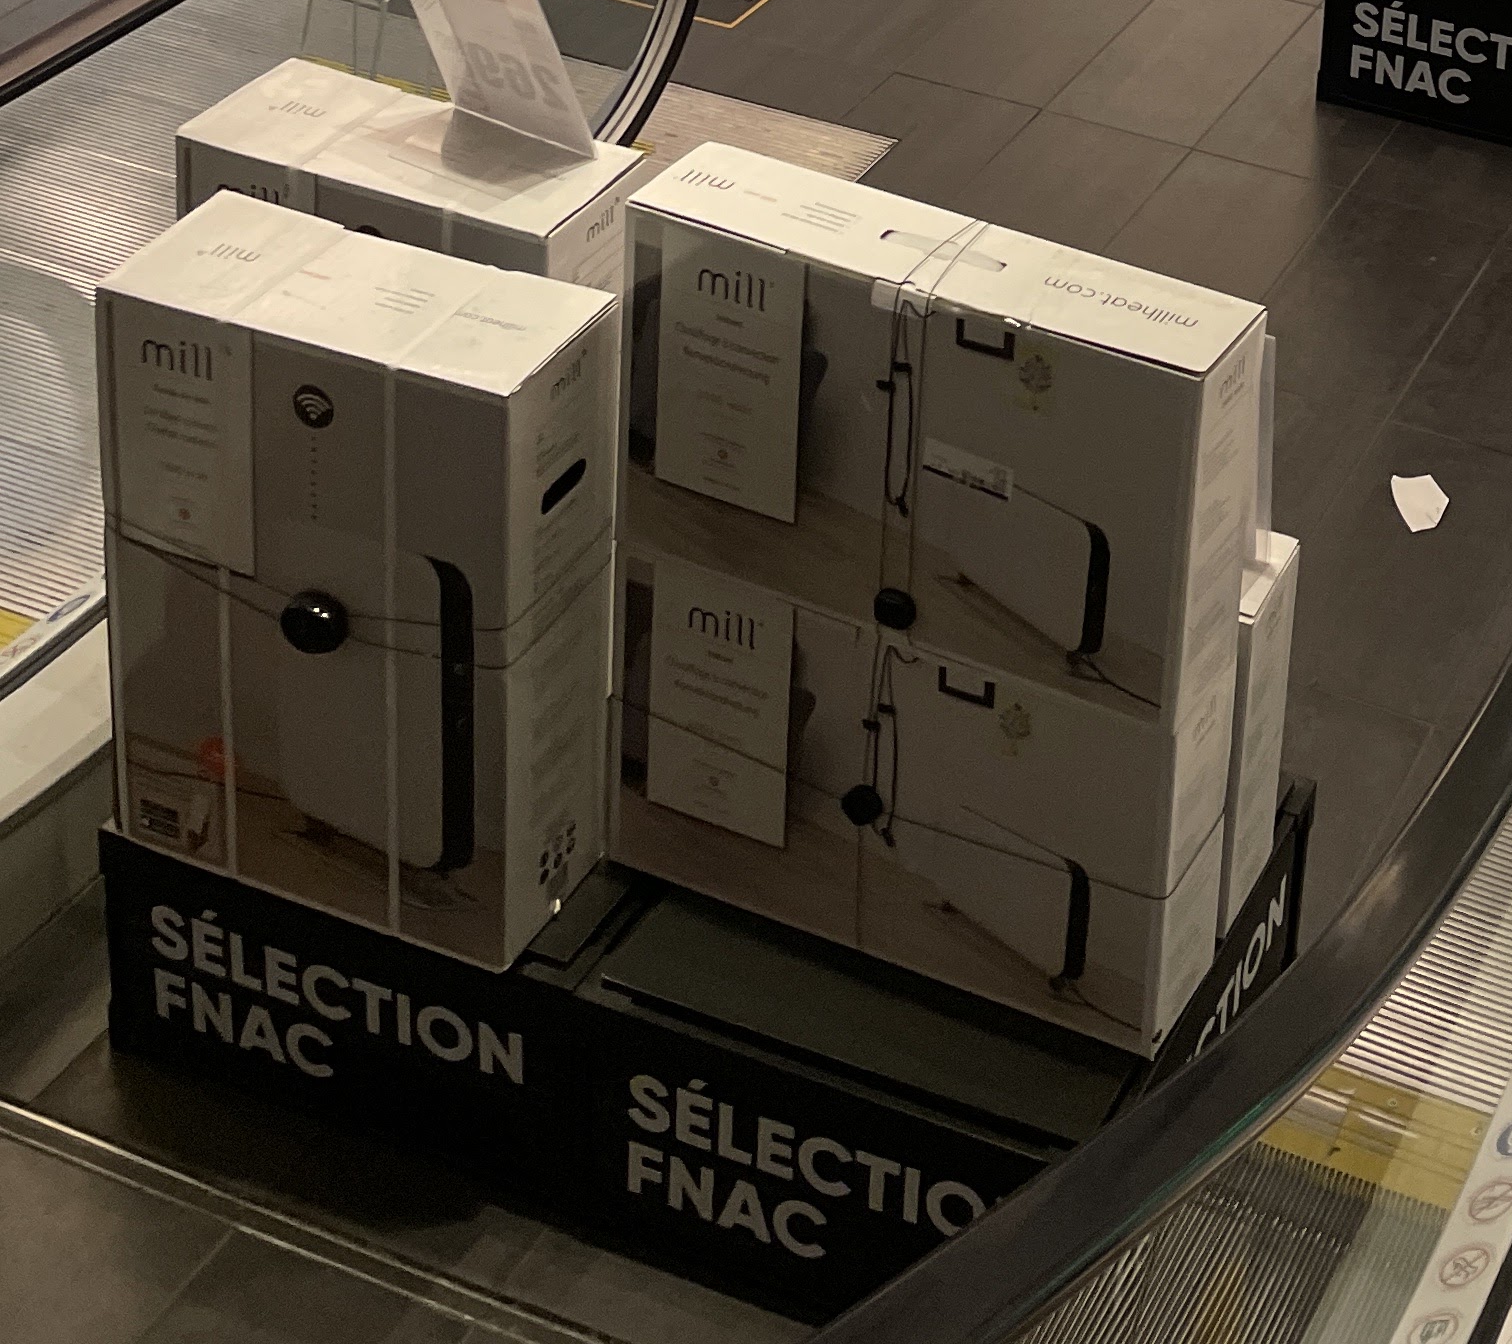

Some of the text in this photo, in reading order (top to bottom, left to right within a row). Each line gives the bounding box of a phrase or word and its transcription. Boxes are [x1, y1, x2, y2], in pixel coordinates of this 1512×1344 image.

[1350, 45, 1471, 105] FNAC
[279, 100, 326, 118] mill
[681, 168, 736, 191] mill
[586, 204, 615, 243] mill
[208, 243, 261, 263] mill
[698, 269, 765, 312] mill
[1043, 275, 1200, 329] millheat.com
[141, 339, 214, 381] mill
[688, 605, 757, 650] mill
[150, 904, 527, 1086] SÉLECTION
[152, 968, 334, 1080] FNAC
[627, 1074, 986, 1238] SÉLECTIO
[627, 1140, 829, 1261] FNAC
